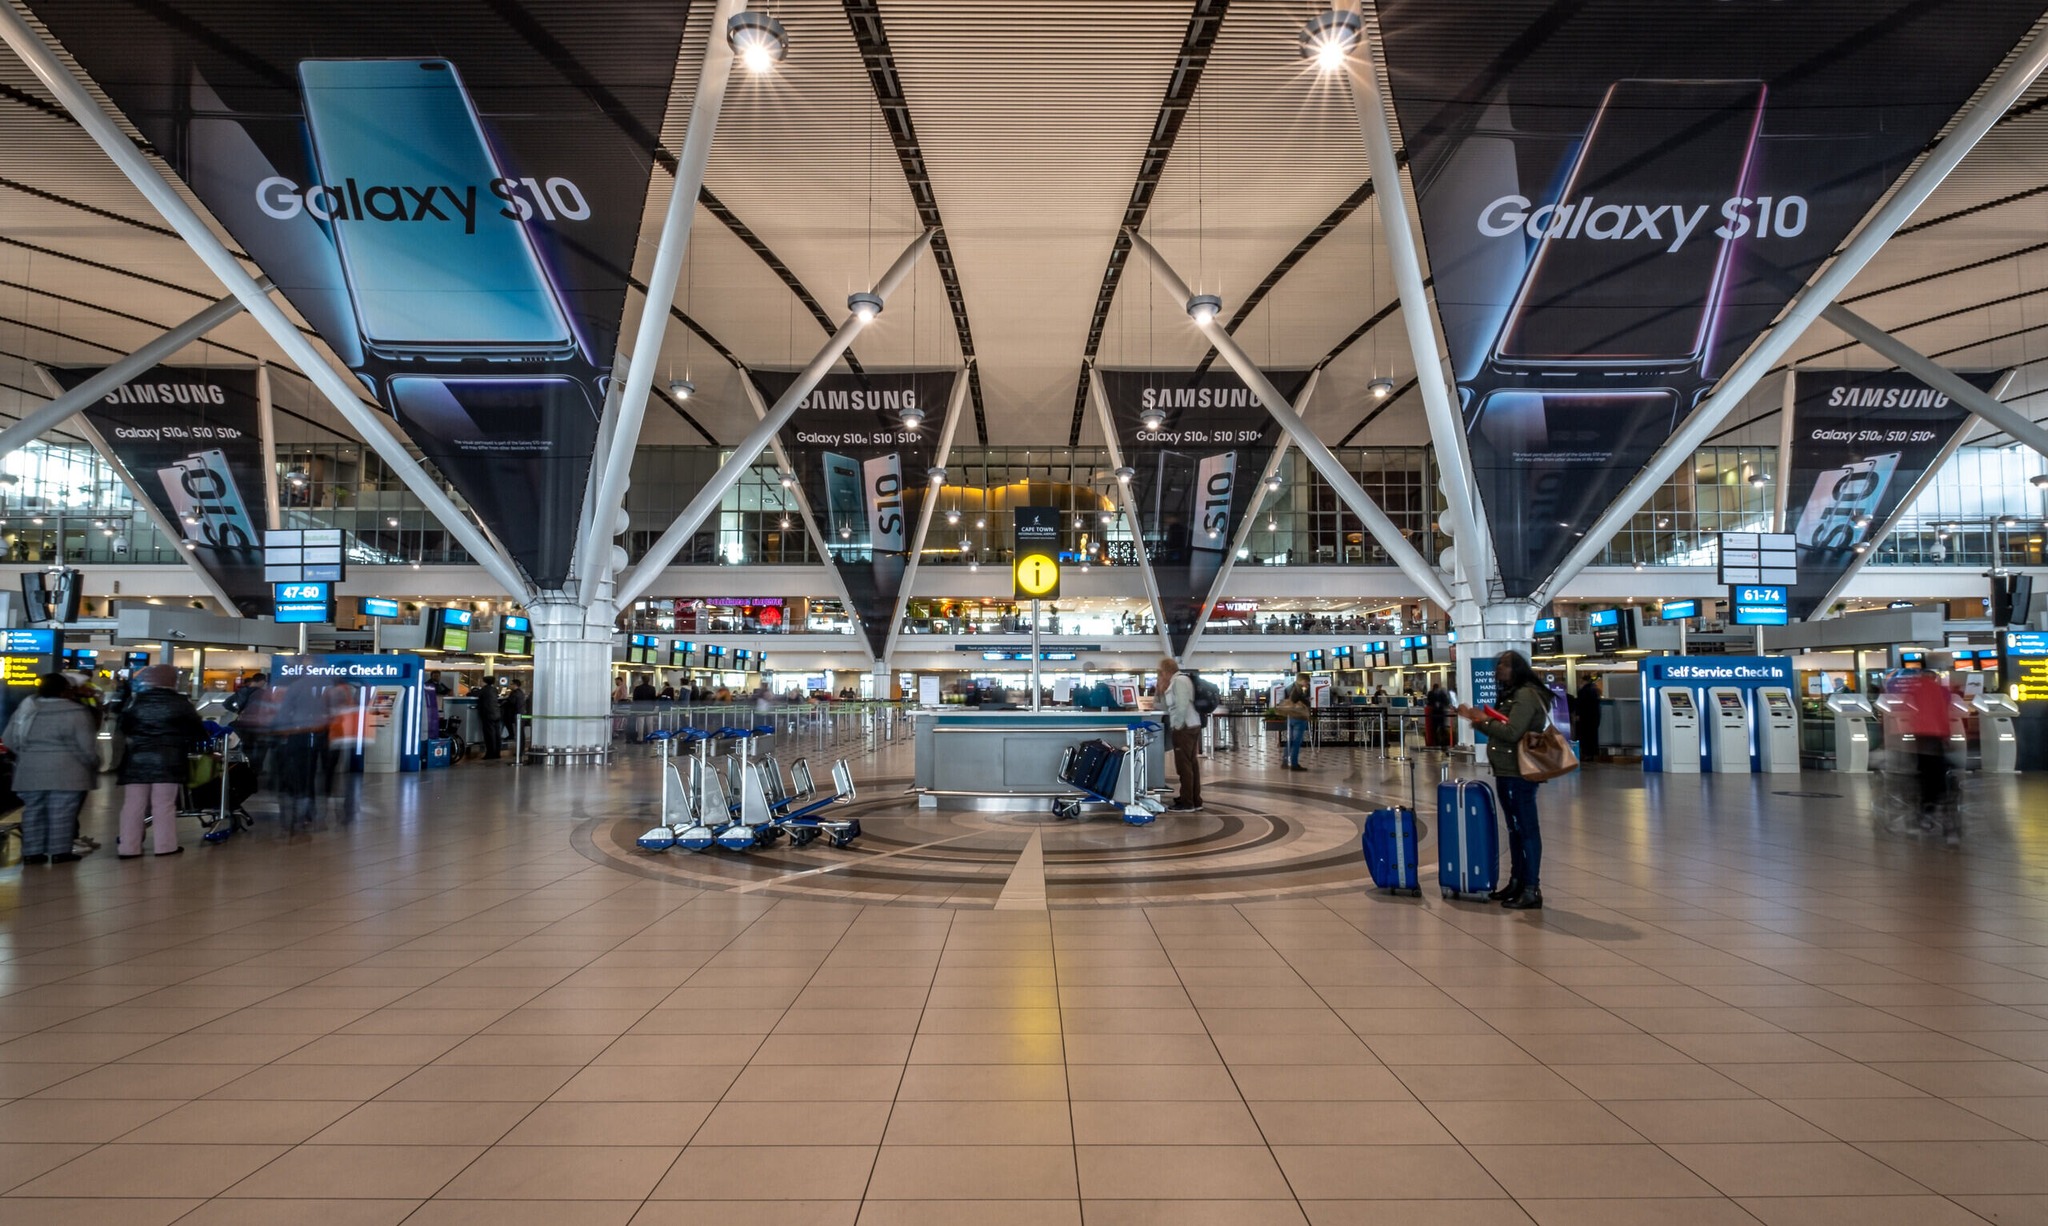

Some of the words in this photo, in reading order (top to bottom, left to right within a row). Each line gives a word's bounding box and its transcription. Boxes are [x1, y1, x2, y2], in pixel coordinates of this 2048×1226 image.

[255, 176, 477, 234] Galaxy
[489, 176, 592, 222] S10
[1476, 195, 1710, 253] Galaxy
[1714, 195, 1808, 240] S10
[105, 383, 225, 404] SAMSUNG
[115, 426, 160, 441] Galaxy
[796, 431, 841, 447] Galaxy
[1136, 430, 1182, 445] Galaxy
[1811, 429, 1858, 444] Galaxy
[181, 468, 250, 548] S10
[875, 473, 904, 537] S10
[1203, 471, 1232, 535] S10
[1811, 471, 1880, 549] S10
[283, 586, 319, 599] 47-60
[1744, 589, 1780, 601] 61-74
[1225, 602, 1258, 611] WIMPY
[1545, 620, 1555, 630] 73
[1590, 613, 1602, 624] 74
[281, 664, 304, 676] Self
[306, 664, 347, 676] Service
[349, 664, 384, 676] Check
[386, 664, 398, 676] In
[1667, 666, 1689, 678] Self
[1691, 666, 1732, 678] Service
[1734, 666, 1769, 678] Check
[1772, 666, 1783, 678] In
